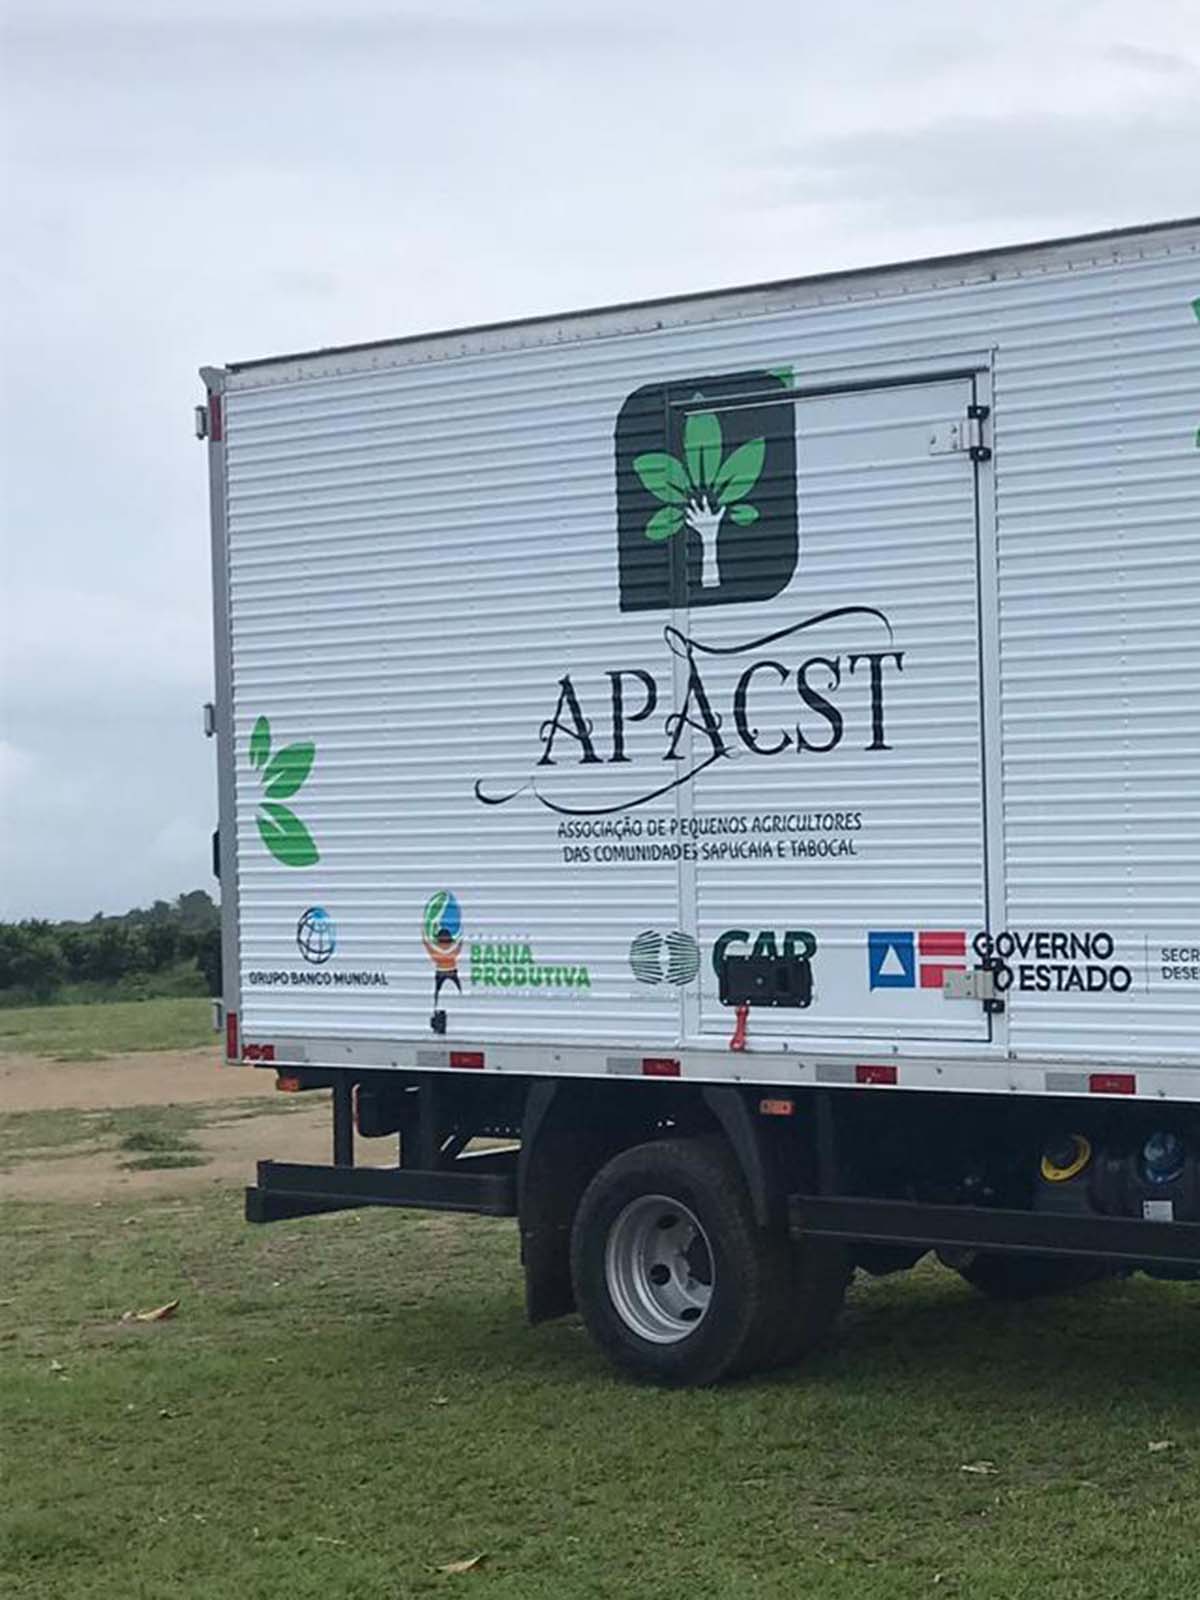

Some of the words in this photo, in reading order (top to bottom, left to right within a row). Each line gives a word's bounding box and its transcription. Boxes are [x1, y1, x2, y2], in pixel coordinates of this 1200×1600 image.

[537, 626, 906, 768] APACST
[558, 816, 643, 840] ASSOCIAÇÃO
[647, 818, 666, 837] DE
[670, 816, 748, 840] PEQUENOS
[751, 811, 863, 833] AGRICULTORES
[563, 845, 591, 863] DAS
[594, 842, 699, 862] COMUNIDADES
[701, 841, 773, 861] SAPUCAIA
[777, 840, 786, 858] E
[790, 838, 858, 857] TABOCAL
[470, 943, 535, 965] BAHIA
[973, 932, 1115, 961] GOVERNO
[248, 971, 289, 986] GRUPO
[290, 971, 332, 986] BANCO
[333, 971, 389, 986] MUNDIAL
[470, 966, 592, 988] PRODUTIVA
[1018, 963, 1133, 993] ESTADO
